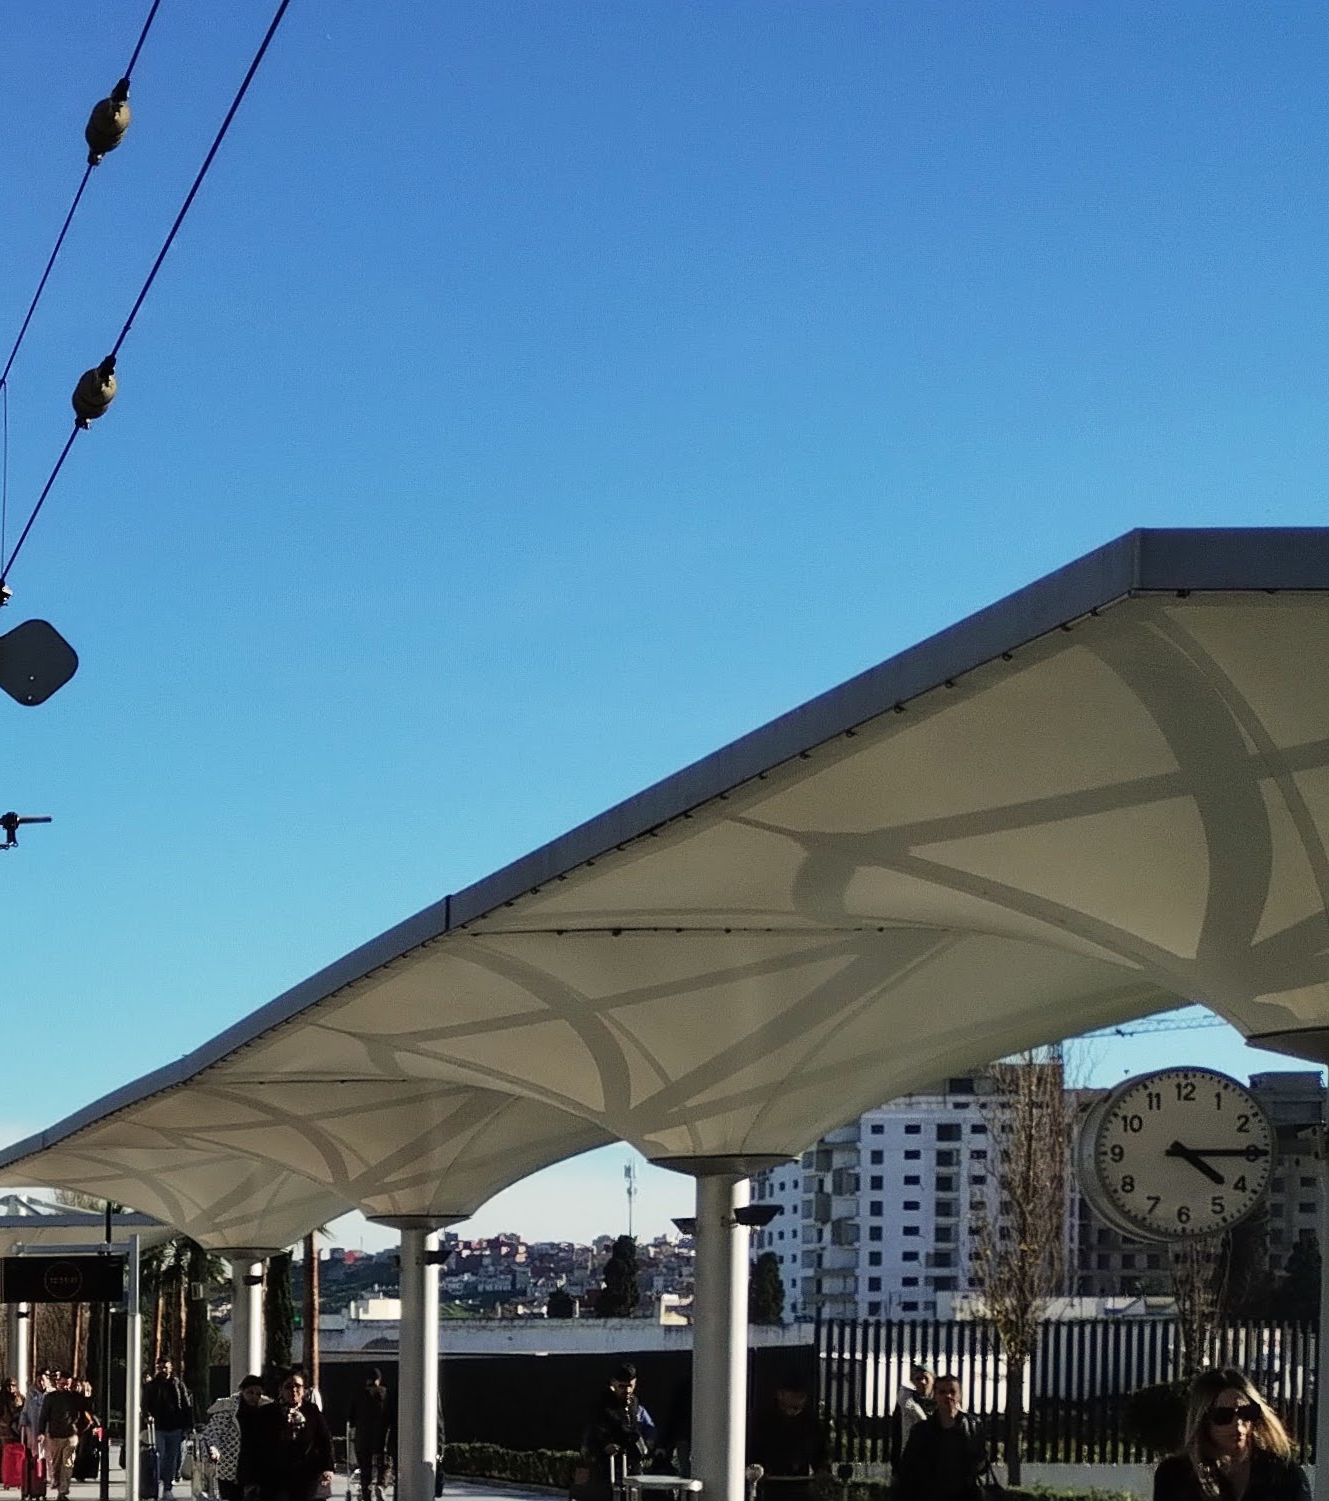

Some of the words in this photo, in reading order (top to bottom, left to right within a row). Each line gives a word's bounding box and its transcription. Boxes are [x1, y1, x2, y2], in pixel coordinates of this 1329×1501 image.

[1175, 1082, 1196, 1101] 12
[1146, 1092, 1161, 1110] 11
[1214, 1092, 1222, 1110] 1
[1121, 1115, 1143, 1133] 10
[1236, 1115, 1250, 1133] 2
[1110, 1144, 1124, 1163] 9
[1121, 1175, 1135, 1193] 8
[1233, 1175, 1247, 1193] 4
[1146, 1196, 1161, 1214] 7
[1211, 1196, 1225, 1214] 5
[1177, 1206, 1190, 1224] 6
